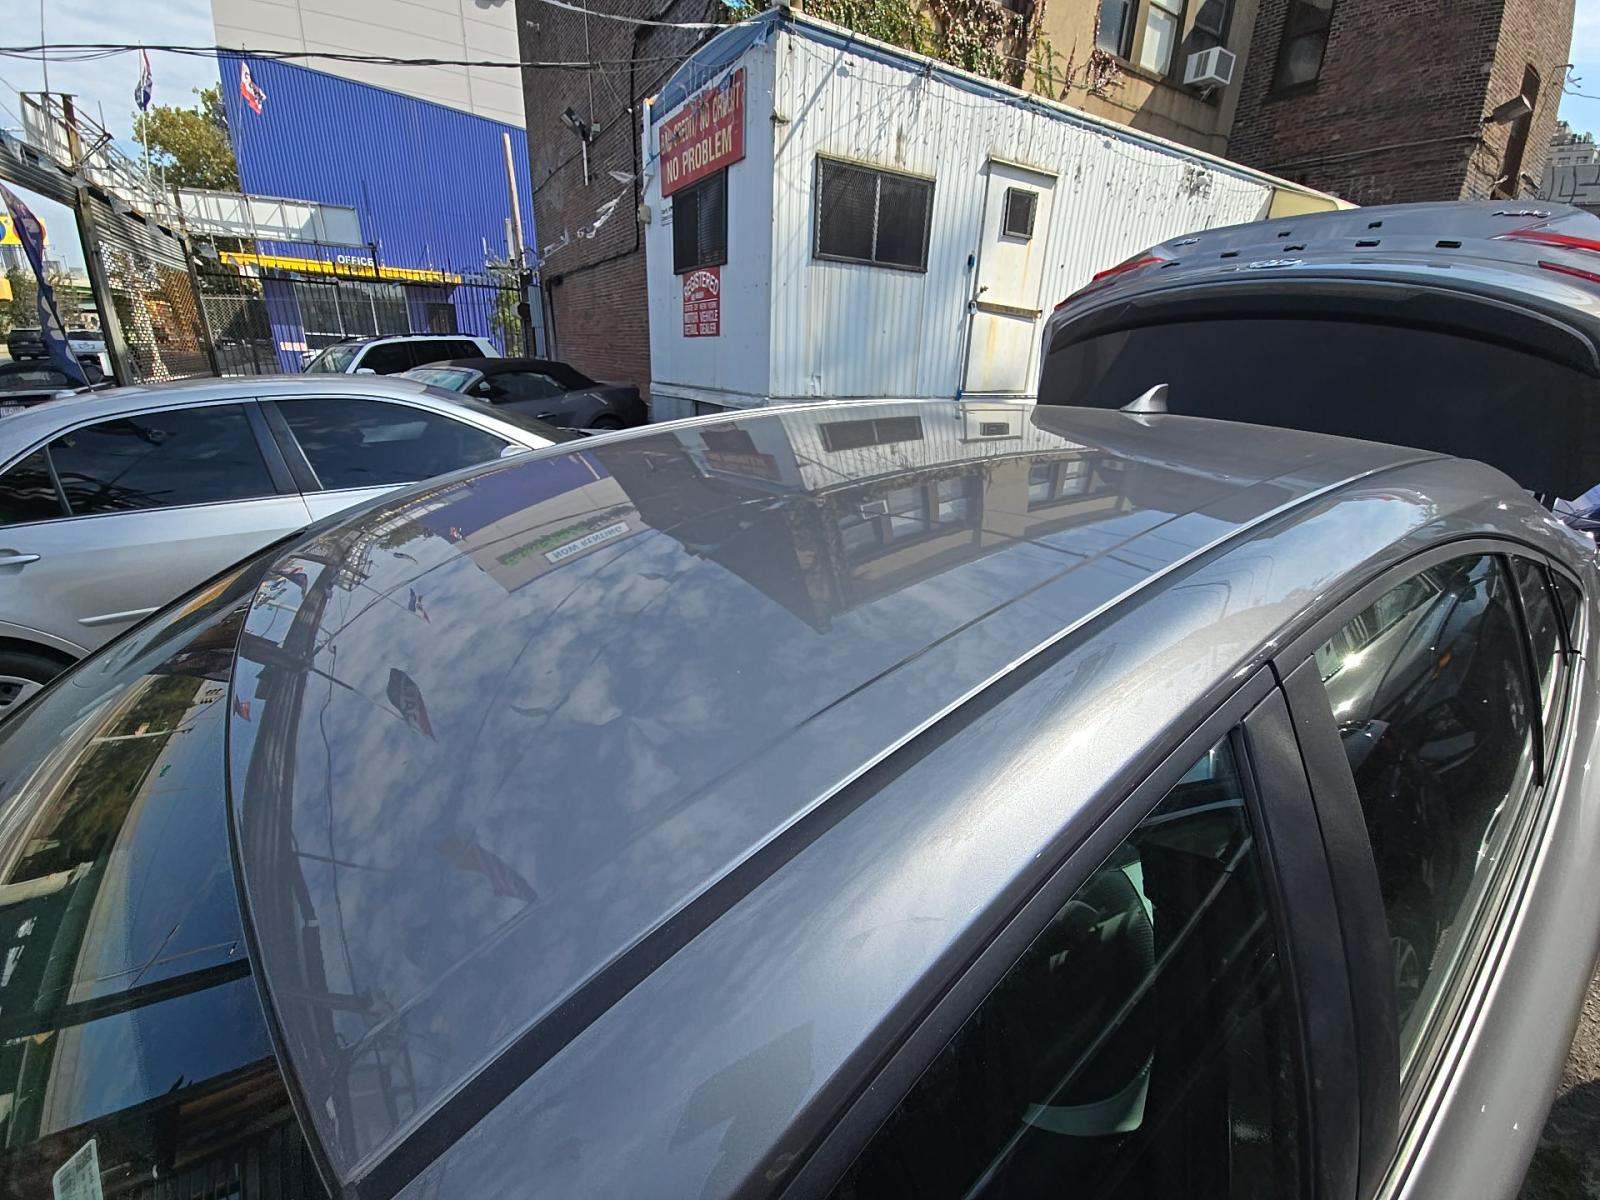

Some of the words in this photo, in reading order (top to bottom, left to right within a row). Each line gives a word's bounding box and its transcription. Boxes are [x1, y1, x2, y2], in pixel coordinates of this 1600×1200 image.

[700, 100, 710, 132] NO
[712, 82, 741, 124] CREDIT
[666, 156, 679, 184] NO
[682, 124, 733, 175] PROBLEM
[337, 254, 374, 266] OFFICE
[684, 271, 719, 296] REGISTERED
[700, 309, 718, 322] VEHICLE
